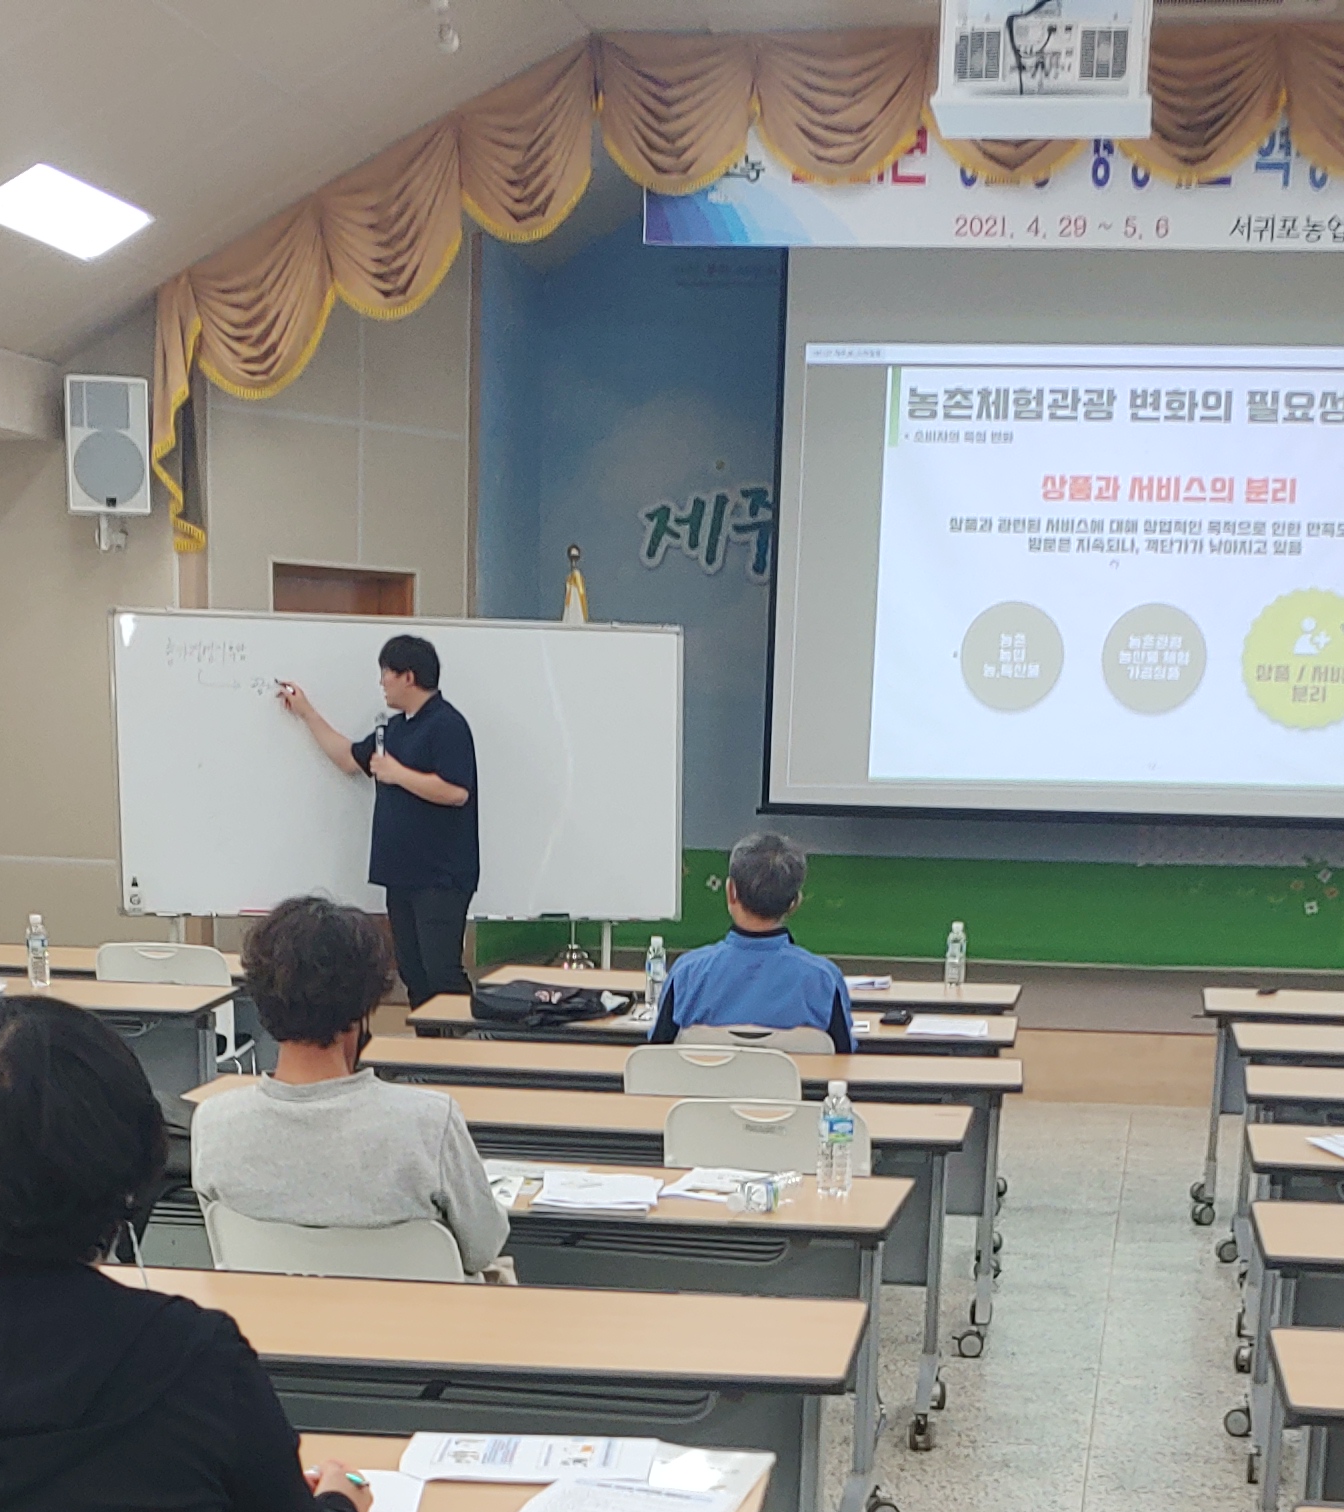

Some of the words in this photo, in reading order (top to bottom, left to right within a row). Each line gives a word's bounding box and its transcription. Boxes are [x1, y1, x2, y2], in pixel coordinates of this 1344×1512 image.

[1058, 216, 1088, 239] 29
[1155, 216, 1171, 239] 6
[907, 385, 1118, 422] 농촌체험관광
[1128, 387, 1234, 423] 변화의
[912, 429, 961, 444] 소비자의
[1041, 473, 1122, 502] 상품과
[1127, 474, 1235, 504] 서비스의
[1244, 476, 1298, 505] 분리
[642, 486, 774, 577] 제주
[948, 516, 993, 534] 상품과
[997, 516, 1042, 535] 관련된
[1045, 517, 1105, 535] 서비스에
[1108, 518, 1139, 535] 대해
[1143, 518, 1203, 536] 상업적인
[1207, 519, 1267, 537] 목적으로
[1271, 520, 1301, 538] 인한
[1075, 537, 1140, 556] 지속되나,
[1208, 538, 1267, 556] 낮아지고
[1272, 539, 1303, 556] 있음
[1255, 664, 1290, 683] 상품
[1291, 684, 1327, 703] 분리
